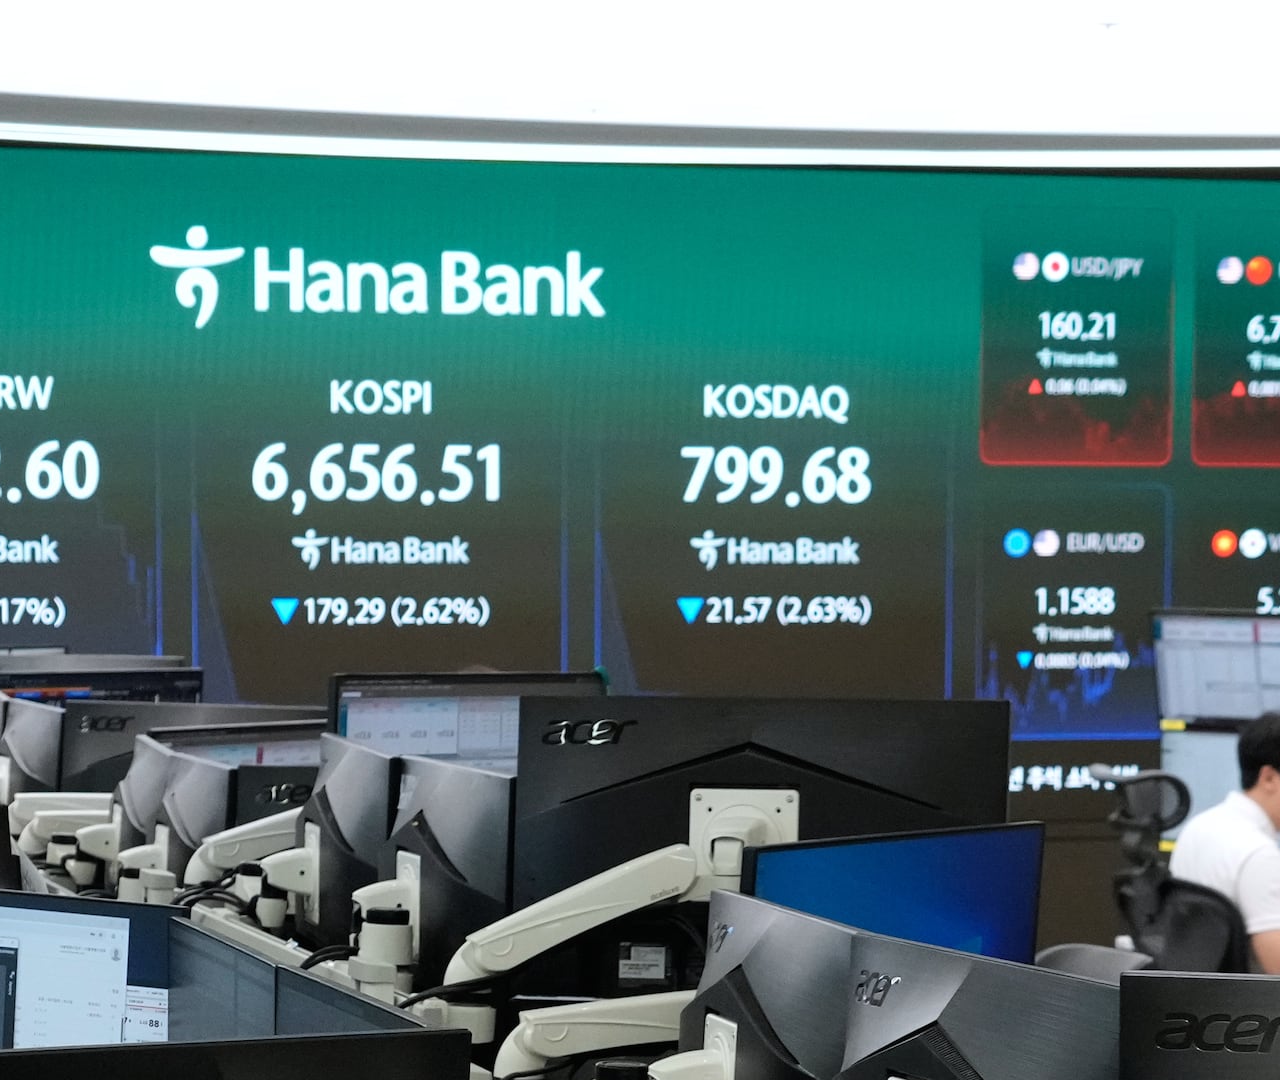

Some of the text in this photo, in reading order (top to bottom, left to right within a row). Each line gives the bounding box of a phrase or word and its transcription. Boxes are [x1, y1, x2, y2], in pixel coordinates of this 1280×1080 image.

[254, 247, 606, 318] Hana Bank
[1071, 257, 1144, 281] USD/JPY
[1038, 311, 1116, 341] 160.21
[329, 380, 432, 415] KOSPI
[703, 384, 849, 424] KOSDAQ
[251, 442, 501, 516] 6,656.51
[680, 445, 872, 508] 799.68
[330, 536, 470, 565] Hana Bank
[727, 536, 860, 565] Hana Bank
[1066, 532, 1145, 554] EUR/USD
[303, 597, 490, 628] 179.29 (2.62%)
[706, 595, 872, 626] 21.57 (2.63%)
[1034, 587, 1116, 616] 1.1588
[80, 715, 136, 734] acer
[541, 719, 638, 745] acer
[1026, 765, 1063, 792] 추석
